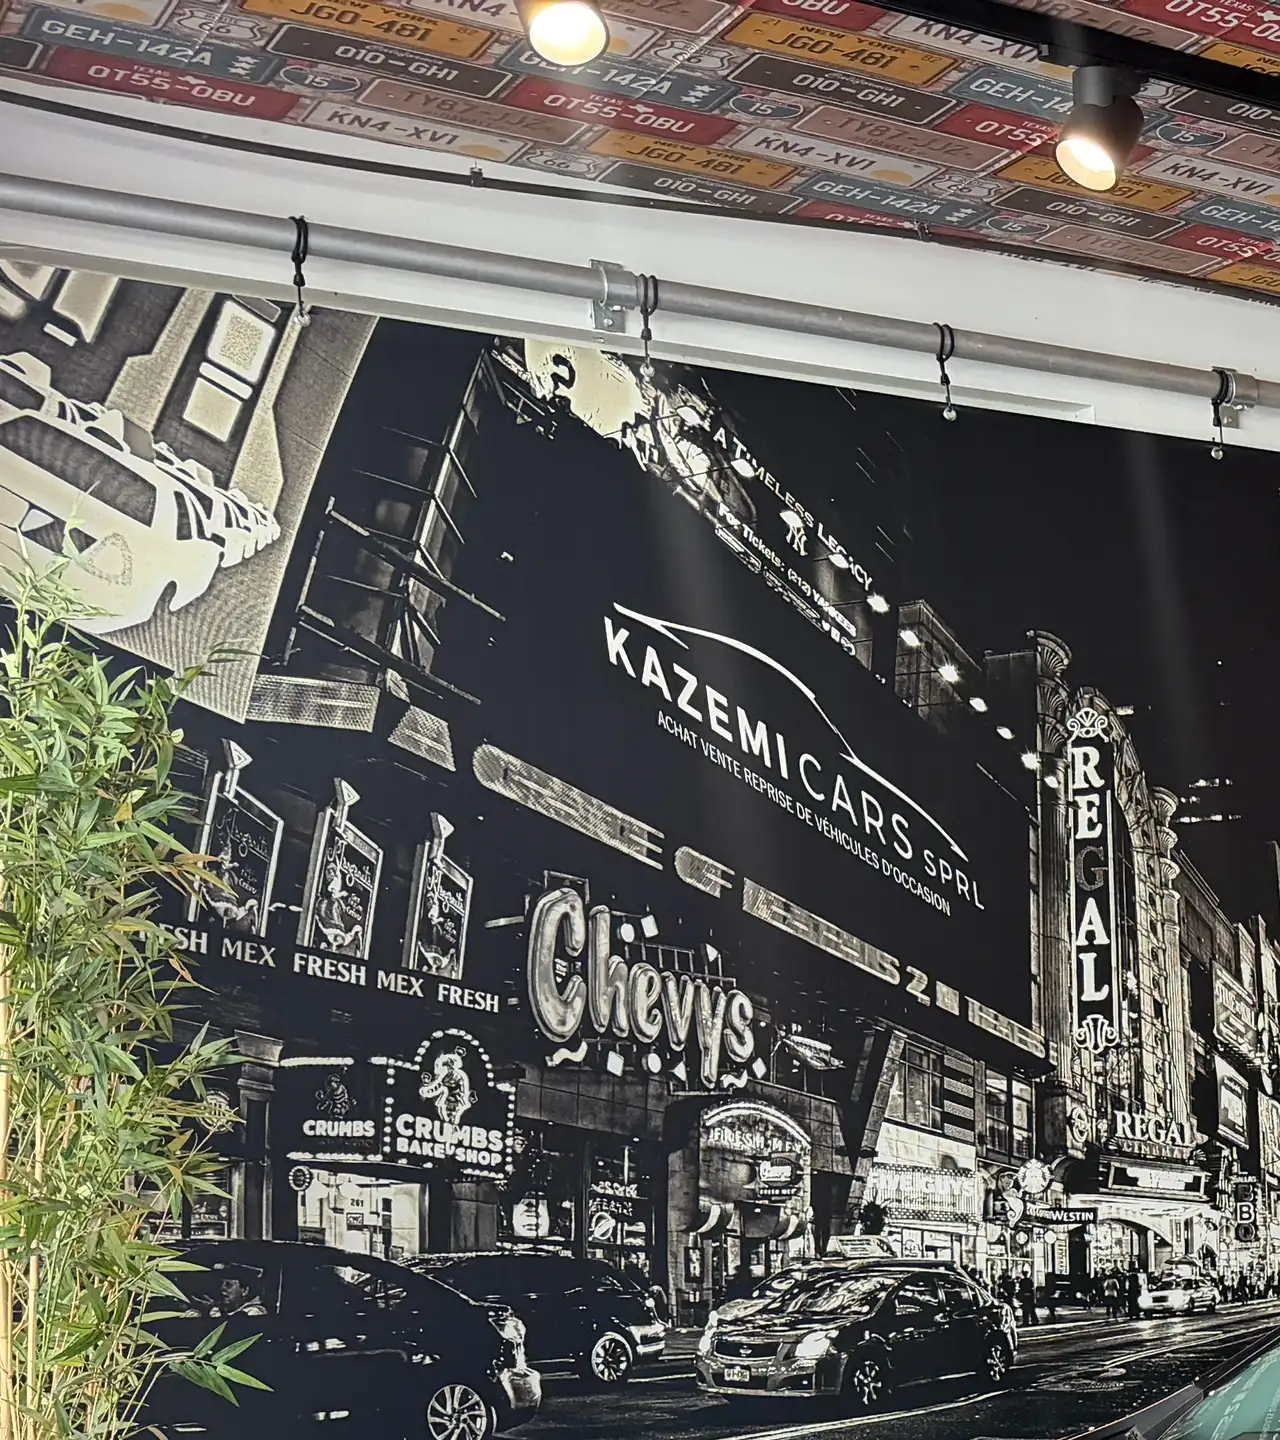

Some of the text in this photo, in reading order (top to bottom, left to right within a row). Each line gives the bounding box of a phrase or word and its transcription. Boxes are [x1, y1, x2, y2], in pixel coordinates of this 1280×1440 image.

[40, 19, 211, 68] GEH-142A
[303, 73, 330, 88] 15
[749, 103, 774, 116] 15
[1170, 130, 1196, 144] 15
[812, 180, 941, 217] GEH-142A
[656, 709, 952, 918] ACHAT VENTE REPRISE DE VÉHICULES D'OCCASION
[923, 850, 986, 911] SPRL
[1071, 745, 1110, 1001] REGAL
[221, 937, 277, 969] MEX
[293, 952, 367, 987] FRESH
[376, 969, 425, 998] MEX
[436, 982, 500, 1014] FRESH
[527, 887, 754, 1089] Chevys
[302, 1119, 376, 1138] CRUMBS
[395, 1113, 504, 1152] CRUMBS
[1113, 1109, 1198, 1149] REGAL
[455, 1147, 503, 1167] SHOP
[869, 1171, 914, 1194] FIVE
[1050, 1208, 1095, 1223] WESTIN
